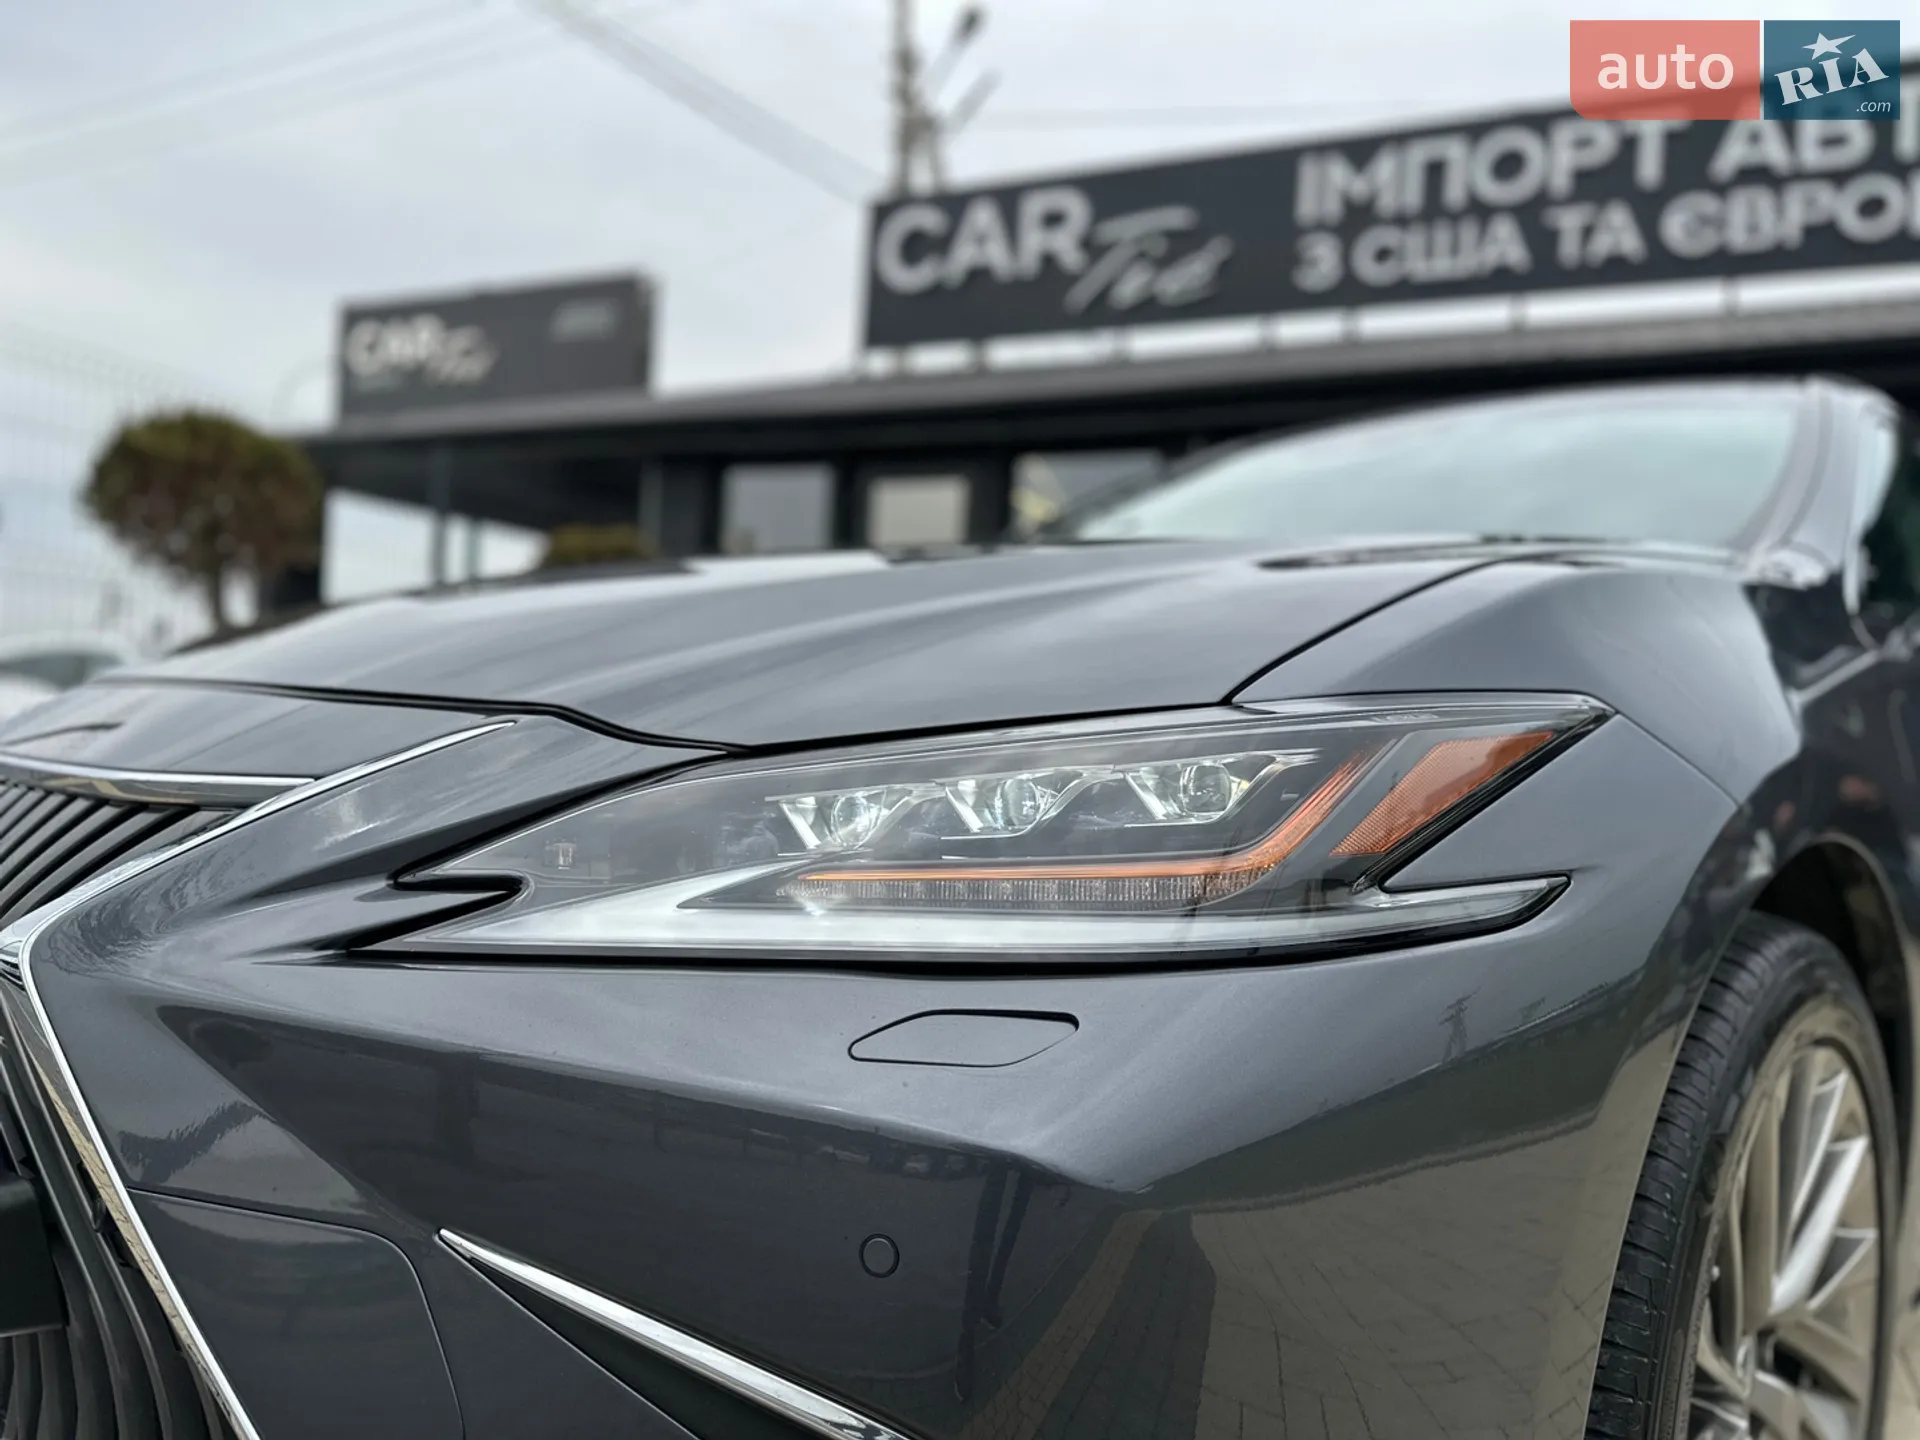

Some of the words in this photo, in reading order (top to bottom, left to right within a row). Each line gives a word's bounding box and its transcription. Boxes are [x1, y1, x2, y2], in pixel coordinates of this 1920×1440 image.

[1297, 104, 1694, 226] ІМПОРТ
[877, 184, 1092, 294] CAR
[1353, 212, 1533, 287] США
[1543, 202, 1647, 269] ТА
